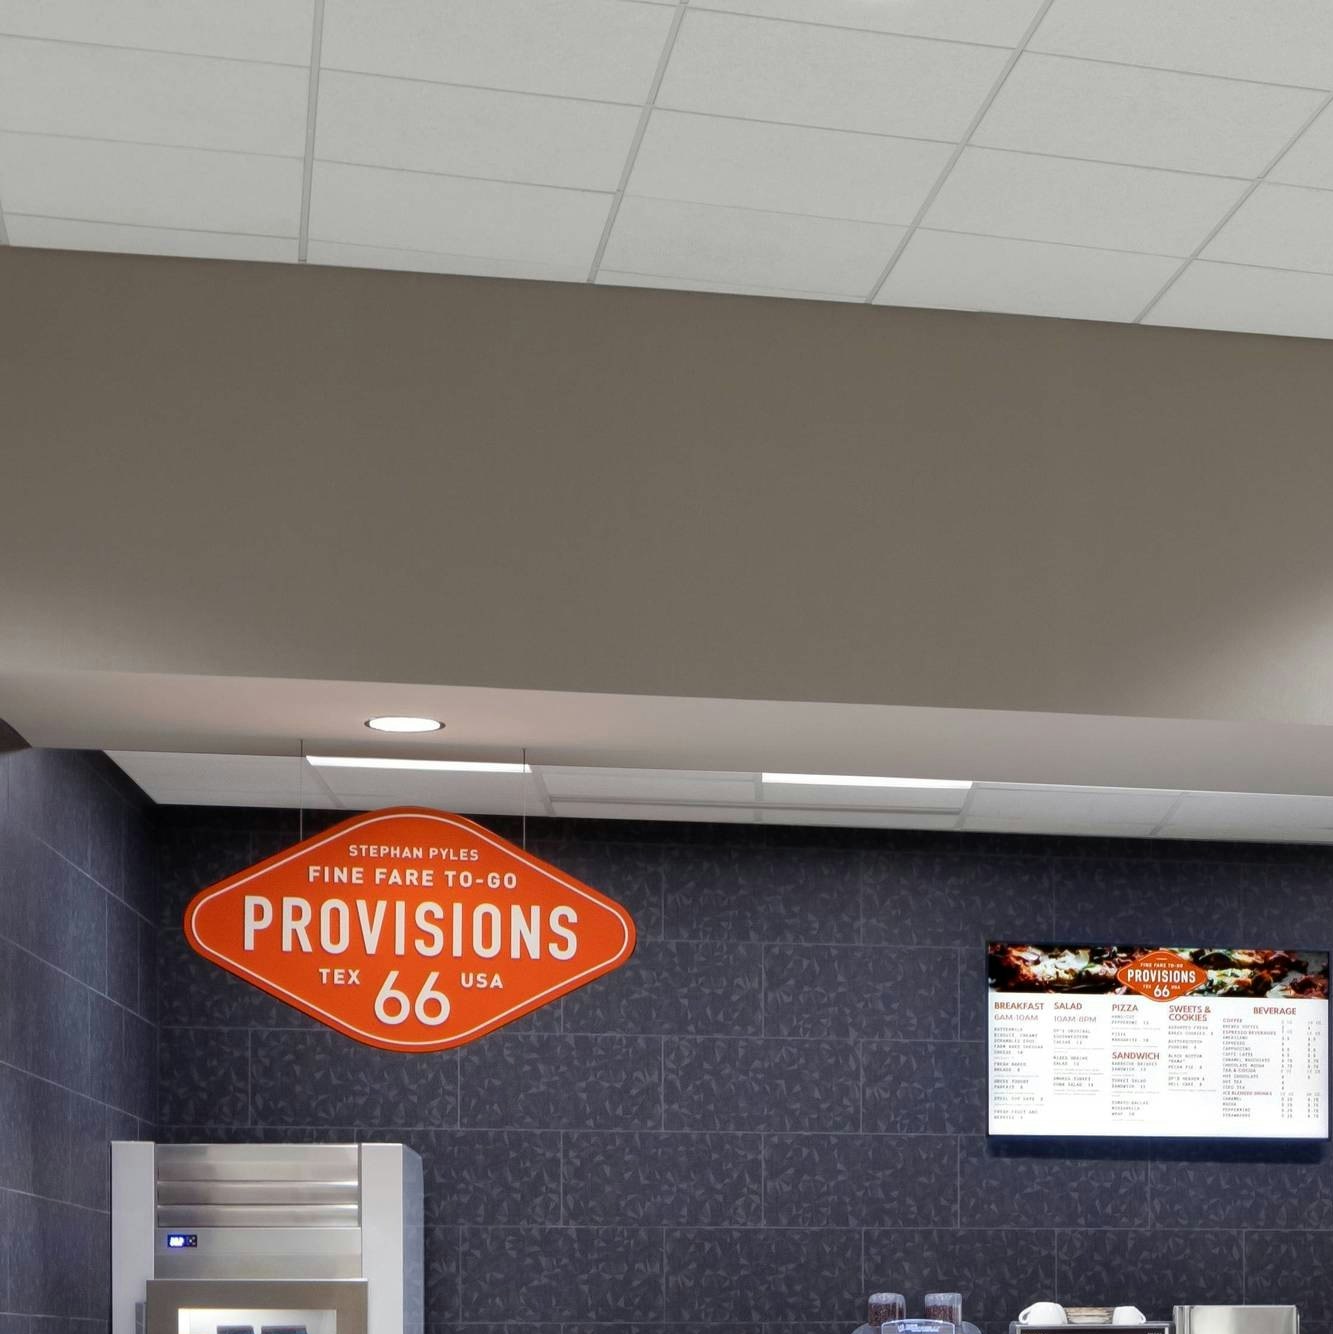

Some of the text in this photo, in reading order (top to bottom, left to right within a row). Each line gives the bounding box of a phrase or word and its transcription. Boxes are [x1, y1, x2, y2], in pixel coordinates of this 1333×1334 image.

[348, 844, 479, 862] STEPHAN PYLES
[308, 865, 518, 889] FINE FARE TO-GO
[243, 895, 579, 961] PROVISIONS
[1127, 969, 1196, 983] PROVISIONS
[1153, 984, 1170, 997] 66
[318, 968, 504, 1027] TEX 66 USA
[994, 1001, 1045, 1010] BREAKFAST
[1053, 1002, 1083, 1010] SALAD
[1112, 1004, 1139, 1012] PIZZA
[1168, 1005, 1211, 1013] SWEETS &
[1253, 1007, 1297, 1015] BEVERAGE
[1168, 1014, 1208, 1022] COOKIES
[1112, 1052, 1160, 1060] SANDWICH
